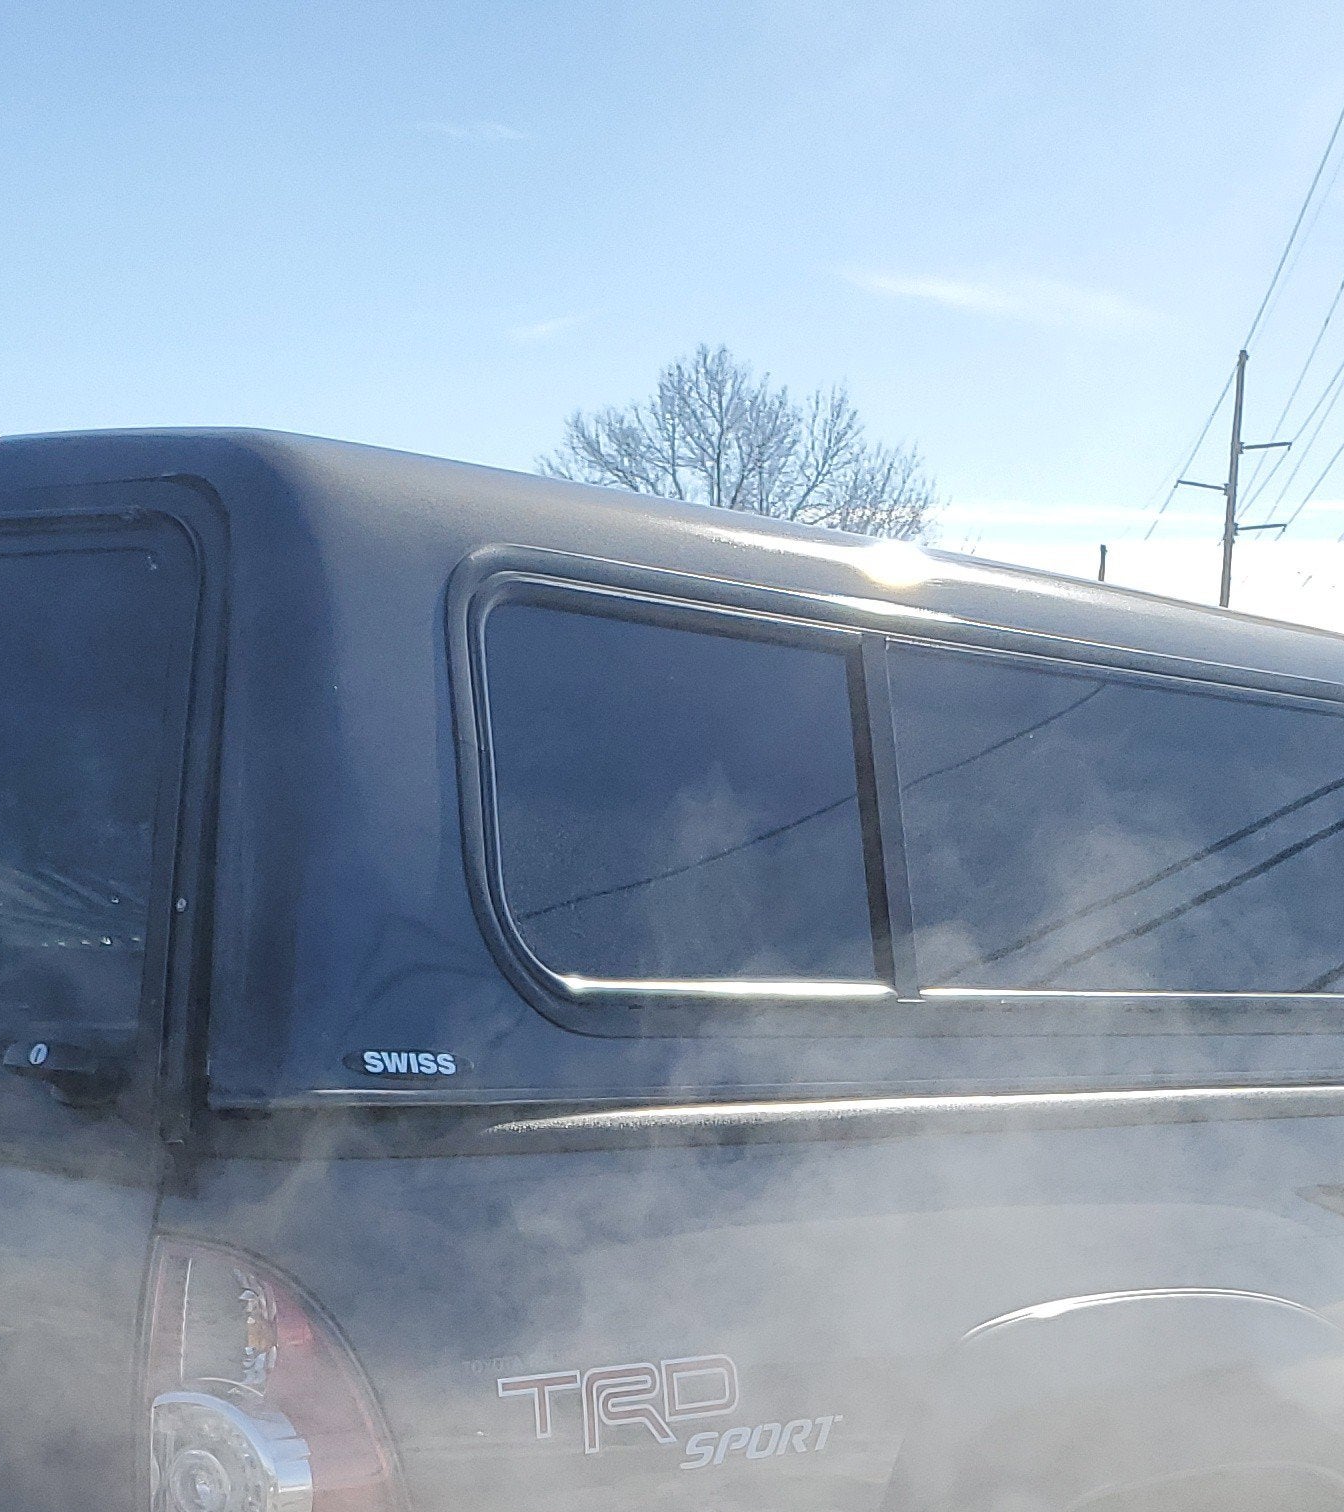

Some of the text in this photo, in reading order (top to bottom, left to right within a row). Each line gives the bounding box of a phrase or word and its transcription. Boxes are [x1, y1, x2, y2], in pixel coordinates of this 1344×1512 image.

[363, 1051, 456, 1075] SWISS
[497, 1354, 739, 1454] TRD
[679, 1415, 844, 1470] SPORT
